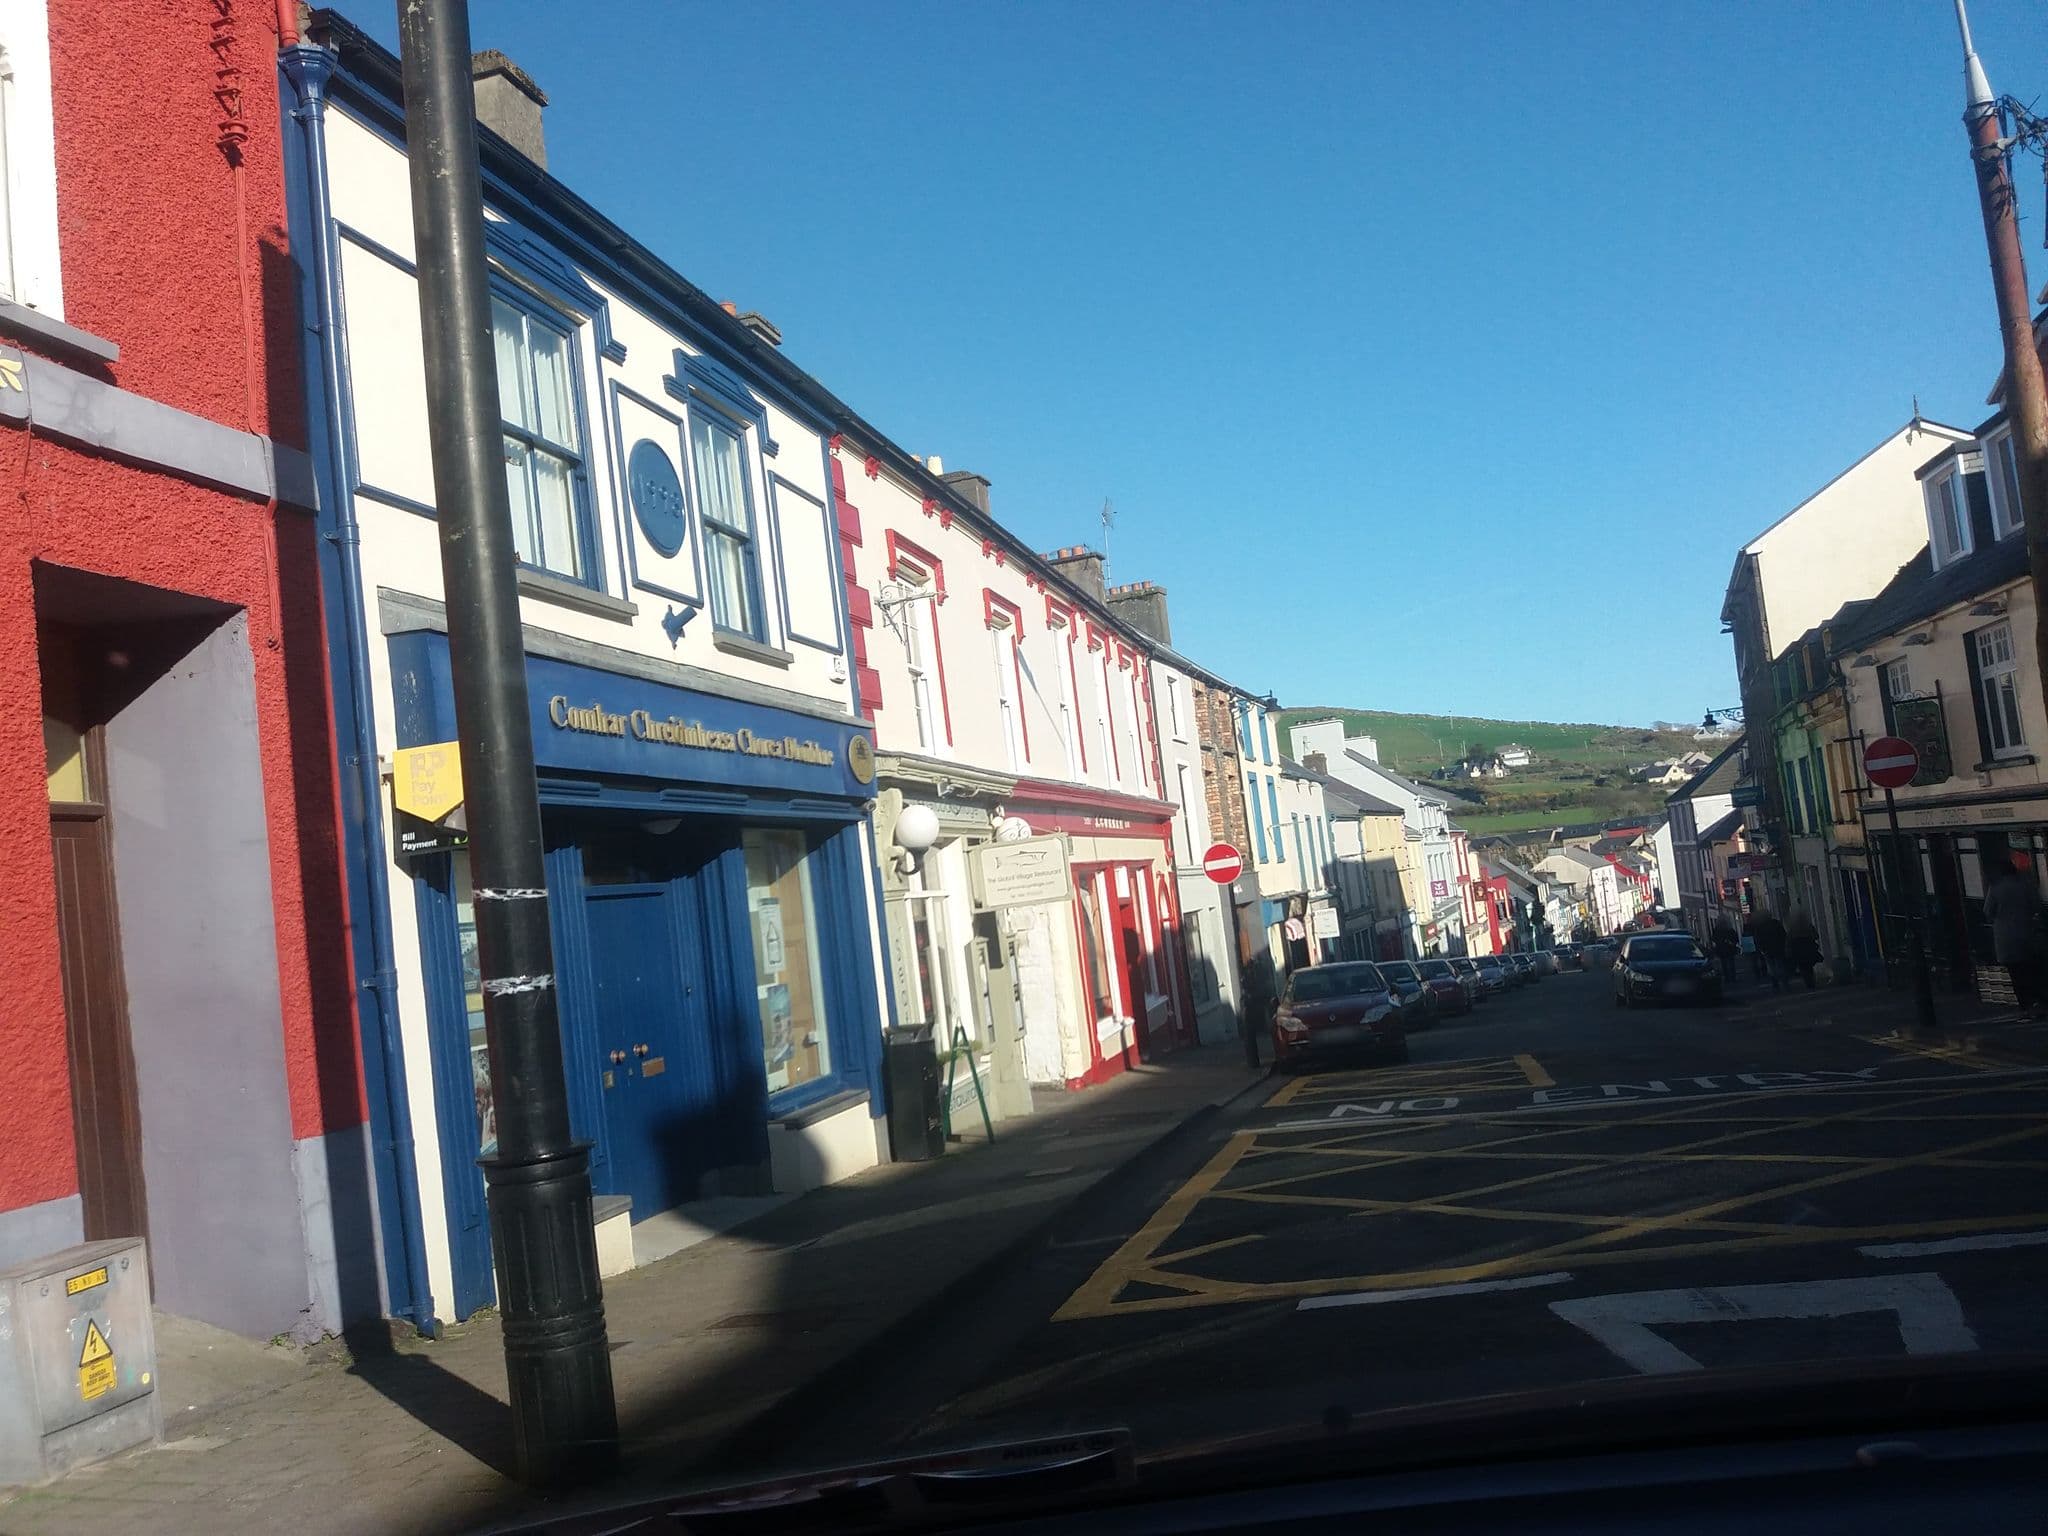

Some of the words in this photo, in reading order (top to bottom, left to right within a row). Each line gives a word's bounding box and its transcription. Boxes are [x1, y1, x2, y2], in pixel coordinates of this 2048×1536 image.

[549, 695, 627, 736] Comhar
[402, 832, 415, 842] Bill
[402, 839, 438, 851] Payment
[1328, 1097, 1459, 1119] NO
[1532, 1066, 1880, 1104] ENTRY
